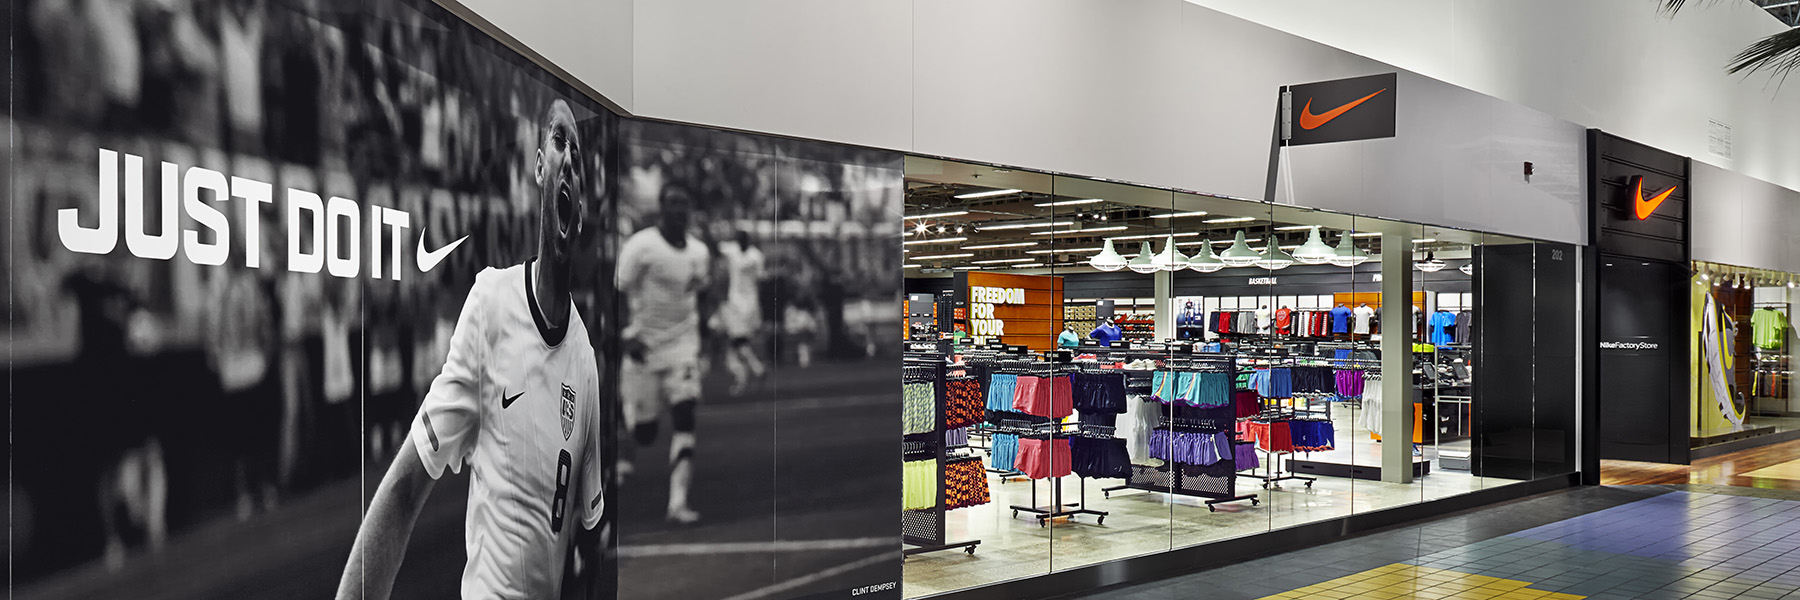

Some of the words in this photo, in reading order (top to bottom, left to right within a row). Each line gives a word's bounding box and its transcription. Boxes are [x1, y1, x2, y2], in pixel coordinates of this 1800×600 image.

[58, 148, 272, 268] JUST
[287, 187, 360, 278] DO
[371, 204, 410, 281] IT
[1551, 248, 1563, 261] 202
[1248, 277, 1277, 285] BASKETBALL
[970, 286, 1025, 304] FREEDOM
[970, 303, 995, 319] FOR
[970, 319, 1004, 336] YOUR
[551, 448, 572, 533] 8
[851, 586, 870, 596] CLINT
[870, 581, 897, 593] DEMPSEY
